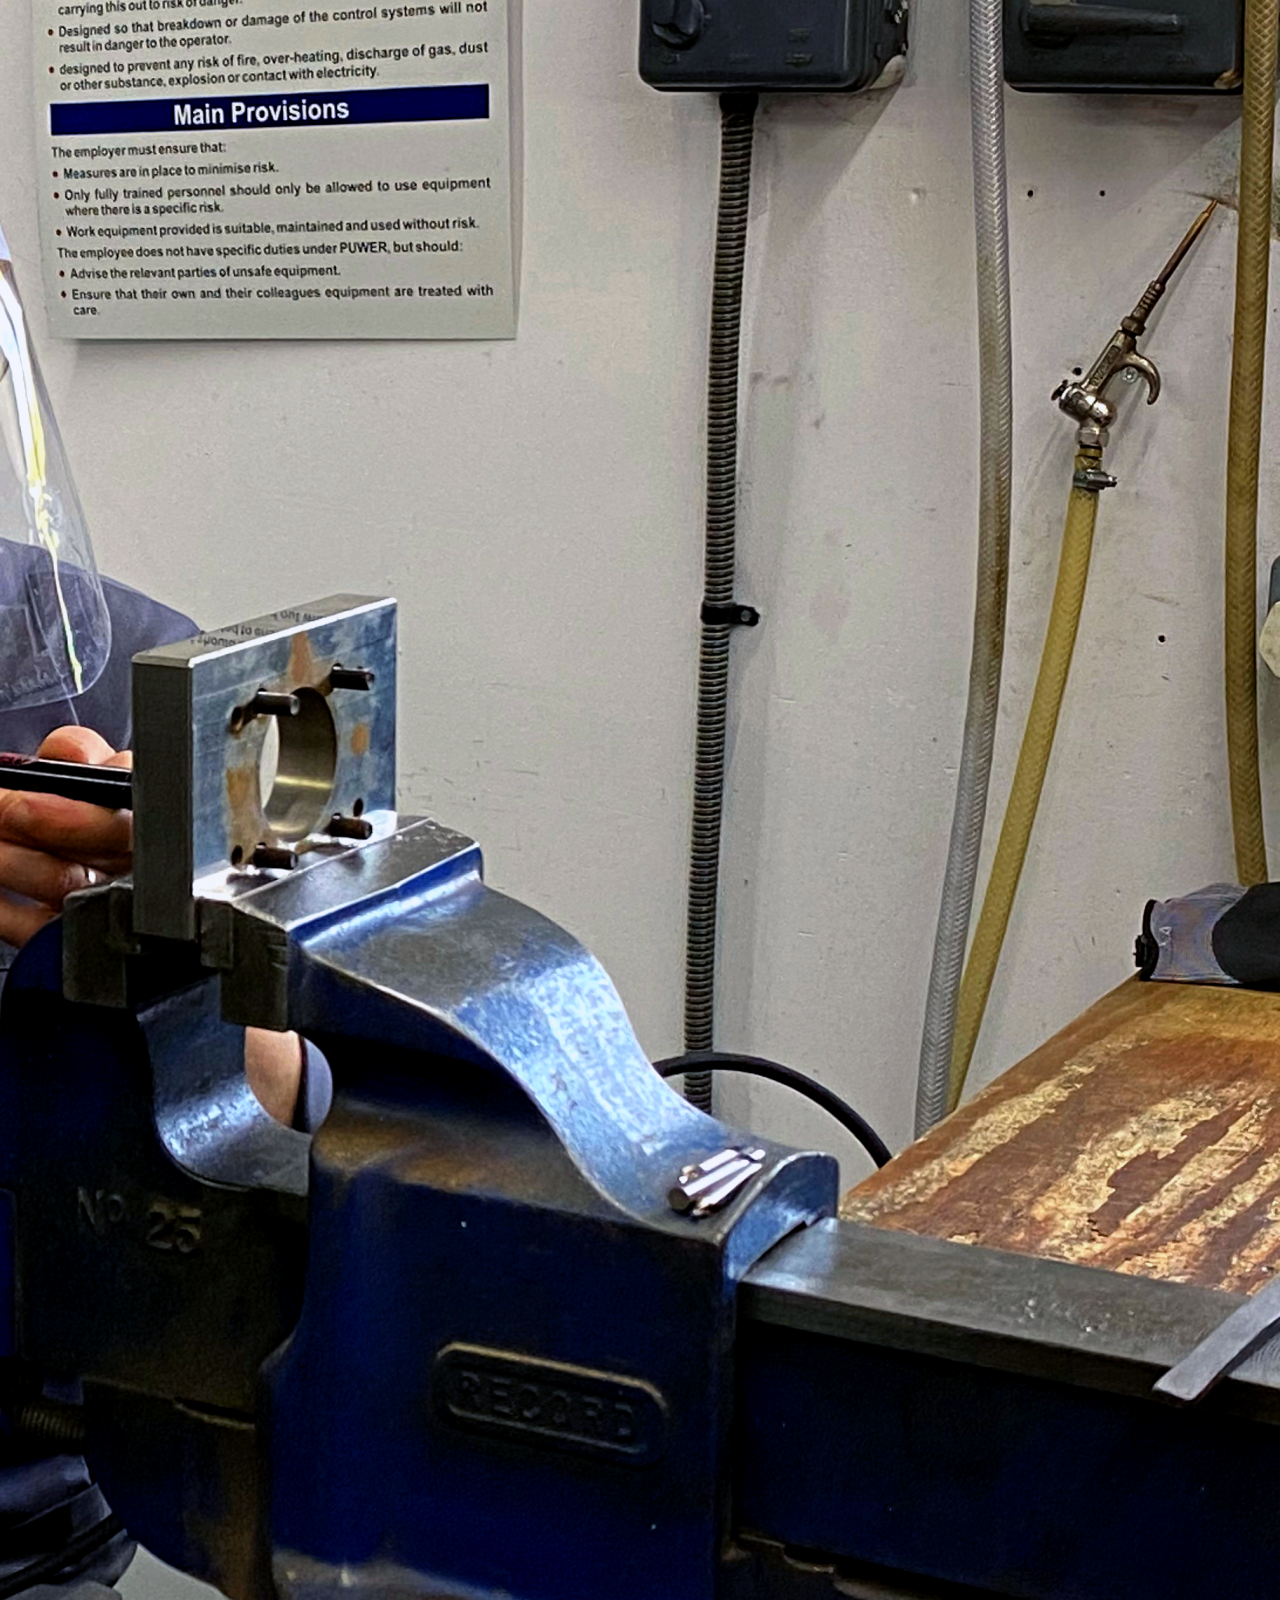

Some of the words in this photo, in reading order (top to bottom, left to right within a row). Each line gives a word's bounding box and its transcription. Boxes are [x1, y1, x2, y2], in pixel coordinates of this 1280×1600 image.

[58, 4, 104, 17] carrying
[105, 1, 126, 12] this
[129, 0, 147, 11] out
[149, 0, 160, 10] to
[163, 0, 184, 9] risk
[59, 23, 110, 38] Designed
[114, 25, 128, 33] so
[132, 21, 153, 32] that
[158, 18, 221, 31] breakdown
[225, 19, 237, 27] or
[242, 15, 289, 26] damage
[294, 12, 305, 23] of
[310, 11, 328, 22] the
[333, 7, 377, 20] control
[381, 6, 435, 20] systems
[440, 2, 461, 14] will
[466, 2, 487, 12] not
[59, 41, 91, 53] result
[92, 41, 102, 51] in
[104, 39, 143, 51] danger
[146, 38, 157, 48] to
[159, 36, 177, 47] the
[180, 34, 232, 48] operator.
[60, 62, 110, 76] designed
[113, 62, 124, 72] to
[128, 59, 170, 74] prevent
[174, 60, 194, 71] any
[198, 56, 218, 68] risk
[223, 55, 234, 66] of
[237, 55, 260, 66] fire,
[263, 51, 343, 64] over-heating,
[347, 47, 408, 59] discharge
[413, 45, 425, 55] of
[429, 46, 455, 57] gas,
[459, 42, 488, 53] dust
[60, 81, 71, 89] or
[74, 78, 102, 89] other
[104, 76, 166, 87] substance,
[169, 73, 225, 87] explosion
[228, 74, 240, 82] or
[242, 70, 287, 81] contact
[289, 68, 313, 79] with
[317, 66, 379, 79] electricity.
[174, 104, 224, 125] Main
[231, 99, 349, 122] Provisions
[52, 147, 72, 158] The
[74, 146, 128, 159] employer
[129, 144, 156, 155] must
[158, 145, 198, 154] ensure
[200, 142, 226, 153] that:
[64, 168, 117, 178] Measures
[119, 168, 136, 177] are
[139, 166, 149, 176] in
[152, 165, 182, 178] place
[185, 165, 195, 175] to
[198, 163, 251, 174] minimise
[254, 162, 279, 173] risk.
[65, 189, 90, 202] Only
[95, 188, 118, 201] fully
[123, 187, 163, 198] trained
[167, 185, 225, 200] personnel
[230, 184, 270, 195] should
[276, 182, 301, 195] only
[306, 182, 320, 192] be
[325, 180, 372, 192] allowed
[378, 181, 389, 191] to
[395, 182, 417, 190] use
[422, 178, 491, 192] equipment
[65, 205, 99, 215] where
[102, 204, 129, 215] there
[132, 204, 141, 214] is
[144, 205, 150, 213] a
[152, 202, 197, 216] specific
[199, 201, 223, 212] risk.
[66, 226, 95, 237] Work
[98, 225, 157, 239] equipment
[160, 224, 210, 238] provided
[212, 224, 222, 234] is
[225, 223, 274, 234] suitable,
[277, 220, 343, 232] maintained
[346, 220, 368, 230] and
[371, 219, 400, 230] used
[403, 219, 450, 229] without
[453, 218, 479, 228] risk.
[58, 247, 78, 258] The
[80, 247, 133, 260] employee
[136, 246, 163, 257] does
[166, 246, 184, 256] not
[187, 245, 214, 256] have
[217, 244, 262, 258] specific
[264, 244, 300, 255] duties
[303, 243, 337, 254] under
[340, 242, 390, 253] PUWER,
[393, 241, 413, 252] but
[415, 240, 463, 252] should:
[71, 268, 108, 278] Advise
[110, 267, 127, 278] the
[130, 267, 175, 278] relevant
[178, 267, 217, 280] parties
[220, 266, 231, 277] of
[233, 266, 272, 277] unsafe
[274, 265, 341, 279] equipment.
[73, 289, 111, 300] Ensure
[115, 289, 137, 299] that
[141, 288, 168, 299] their
[172, 290, 195, 299] own
[200, 288, 221, 298] and
[226, 287, 252, 298] their
[257, 287, 320, 300] colleagues
[325, 286, 390, 299] equipment
[394, 288, 413, 296] are
[418, 285, 462, 296] treated
[467, 285, 493, 295] with
[73, 307, 99, 315] care.
[147, 1200, 202, 1254] 25
[456, 1370, 635, 1442] RECORD
